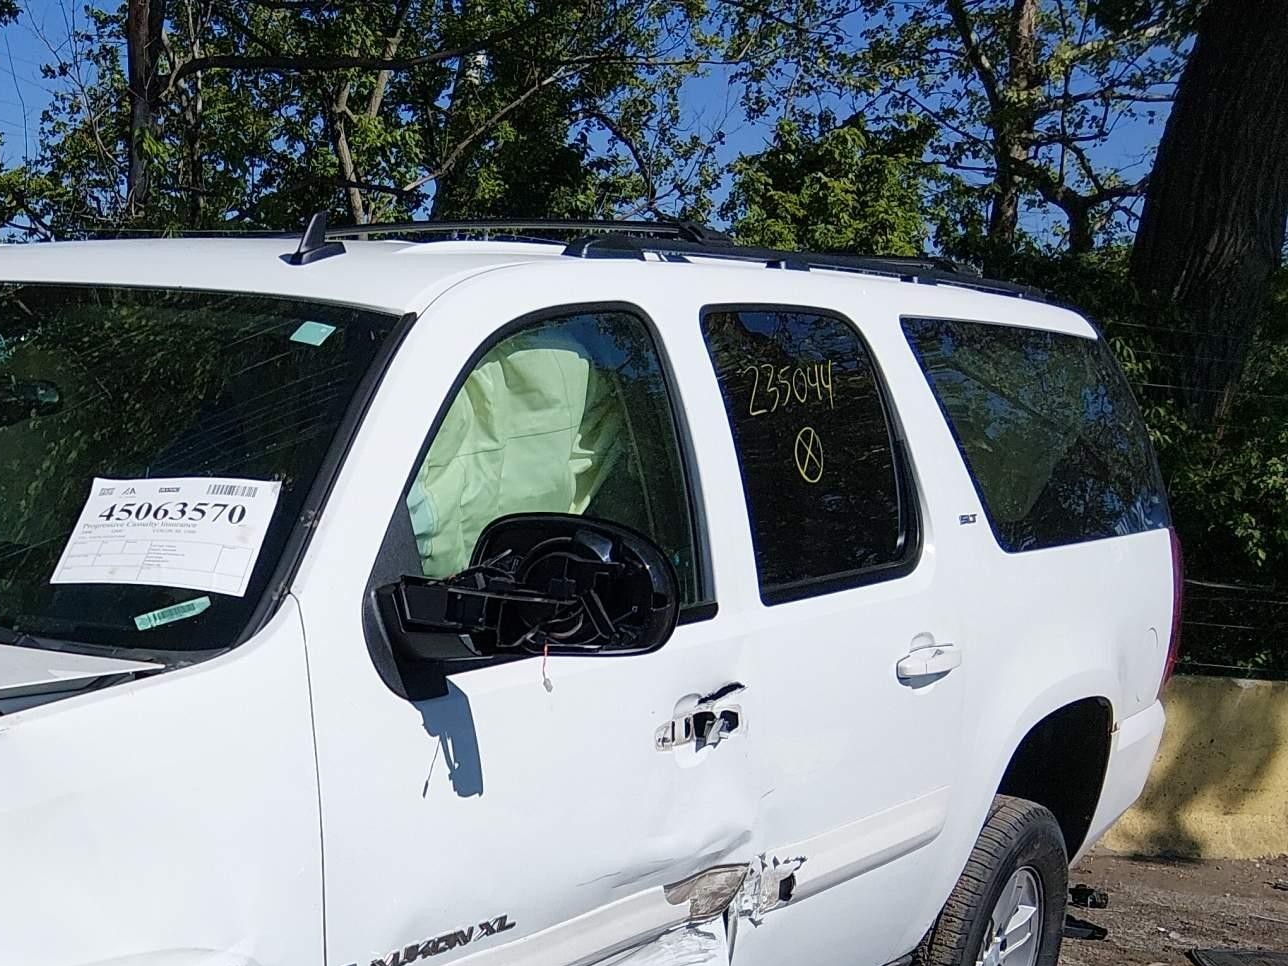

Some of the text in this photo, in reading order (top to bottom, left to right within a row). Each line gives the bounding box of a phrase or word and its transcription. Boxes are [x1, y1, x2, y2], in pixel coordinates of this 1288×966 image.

[743, 359, 835, 416] 235044
[82, 520, 198, 530] Progressive Casualty Insurance
[98, 501, 247, 525] 45063570
[473, 913, 517, 942] XL
